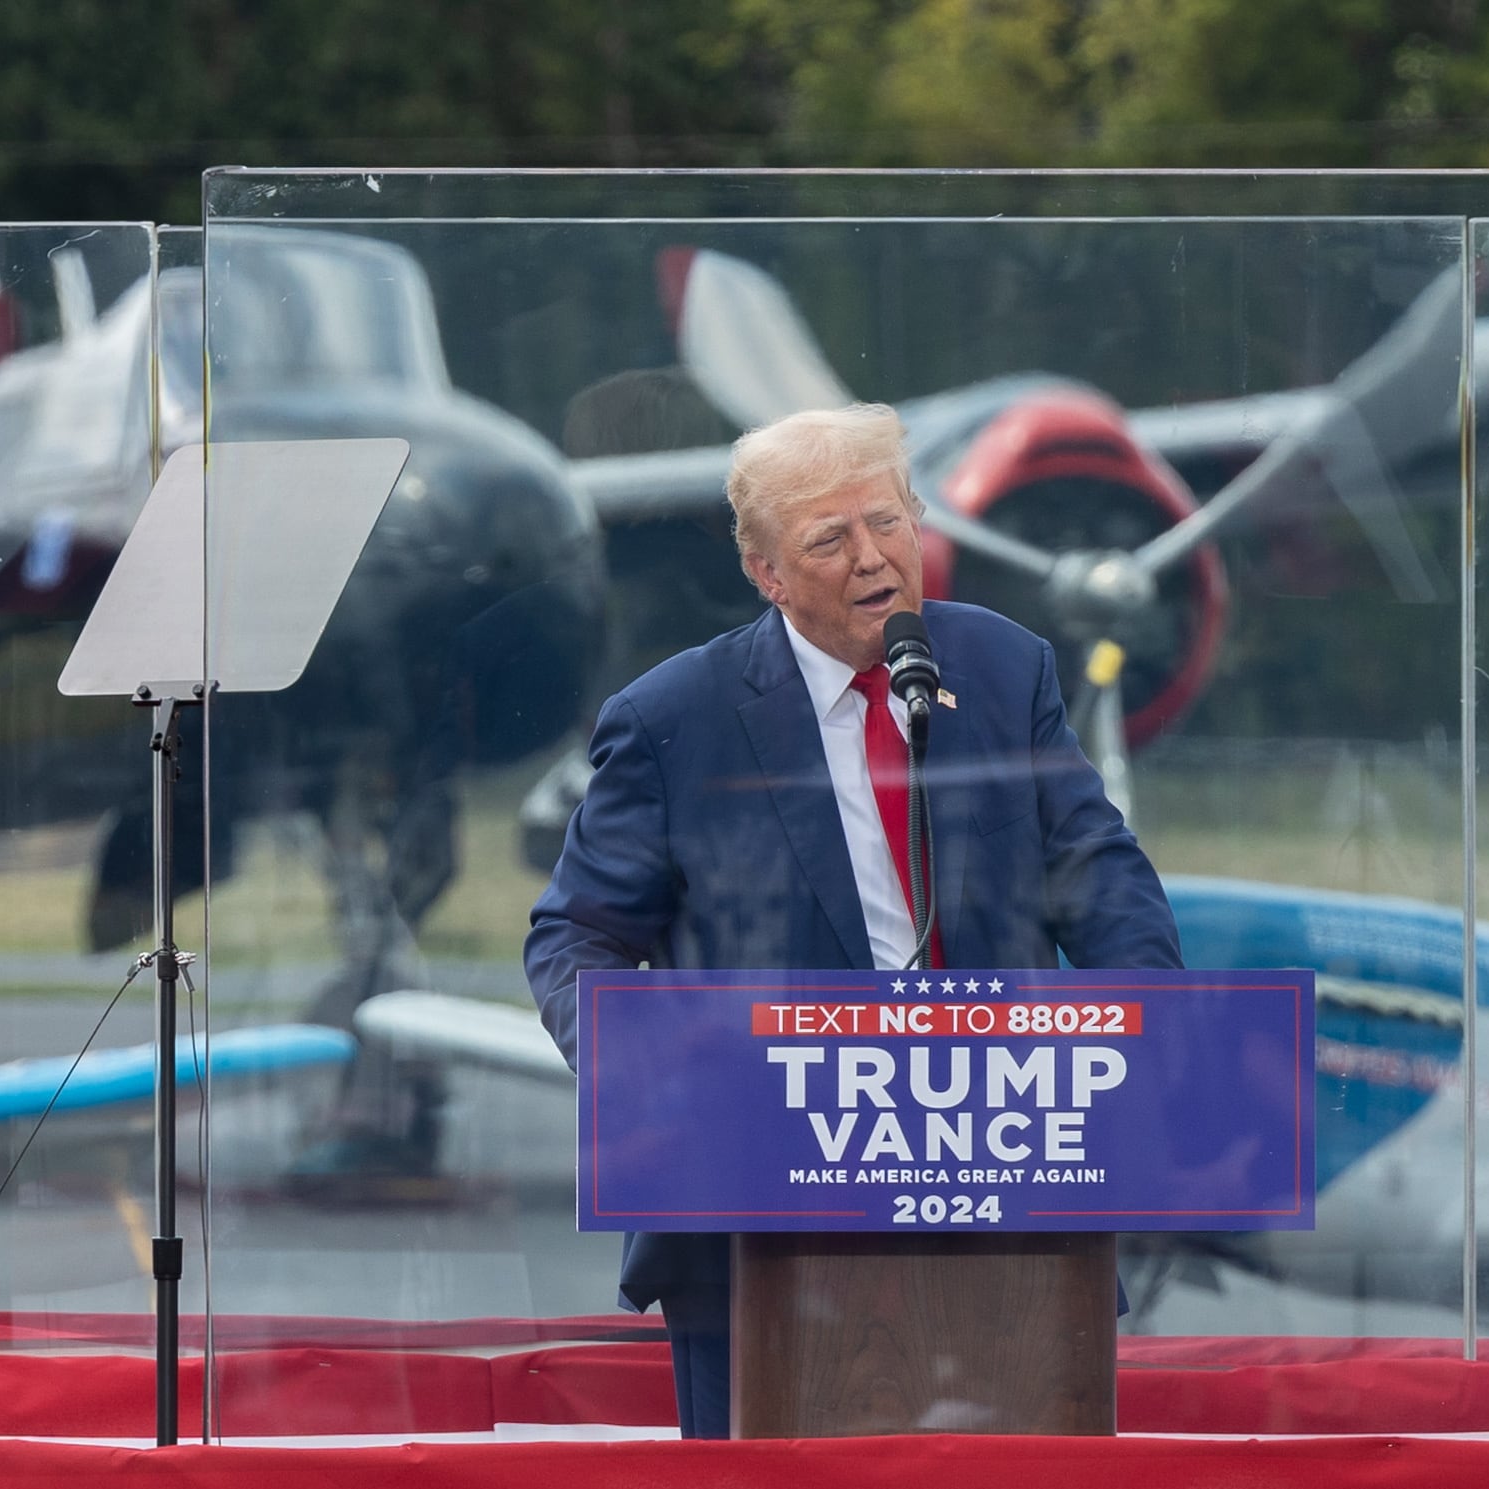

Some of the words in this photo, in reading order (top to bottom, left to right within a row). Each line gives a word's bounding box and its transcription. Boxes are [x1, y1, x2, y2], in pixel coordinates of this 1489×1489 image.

[770, 1005, 867, 1034] TEXT
[879, 1005, 934, 1034] NC
[945, 1005, 995, 1034] TO
[1007, 1005, 1125, 1034] 88022
[767, 1046, 1128, 1109] TRUMP
[808, 1111, 1086, 1163] VANCE
[789, 1169, 848, 1184] MAKE
[855, 1168, 950, 1184] AMERICA
[957, 1168, 1025, 1184] GREAT
[1032, 1168, 1106, 1184] AGAIN!
[892, 1194, 1003, 1224] 2024
